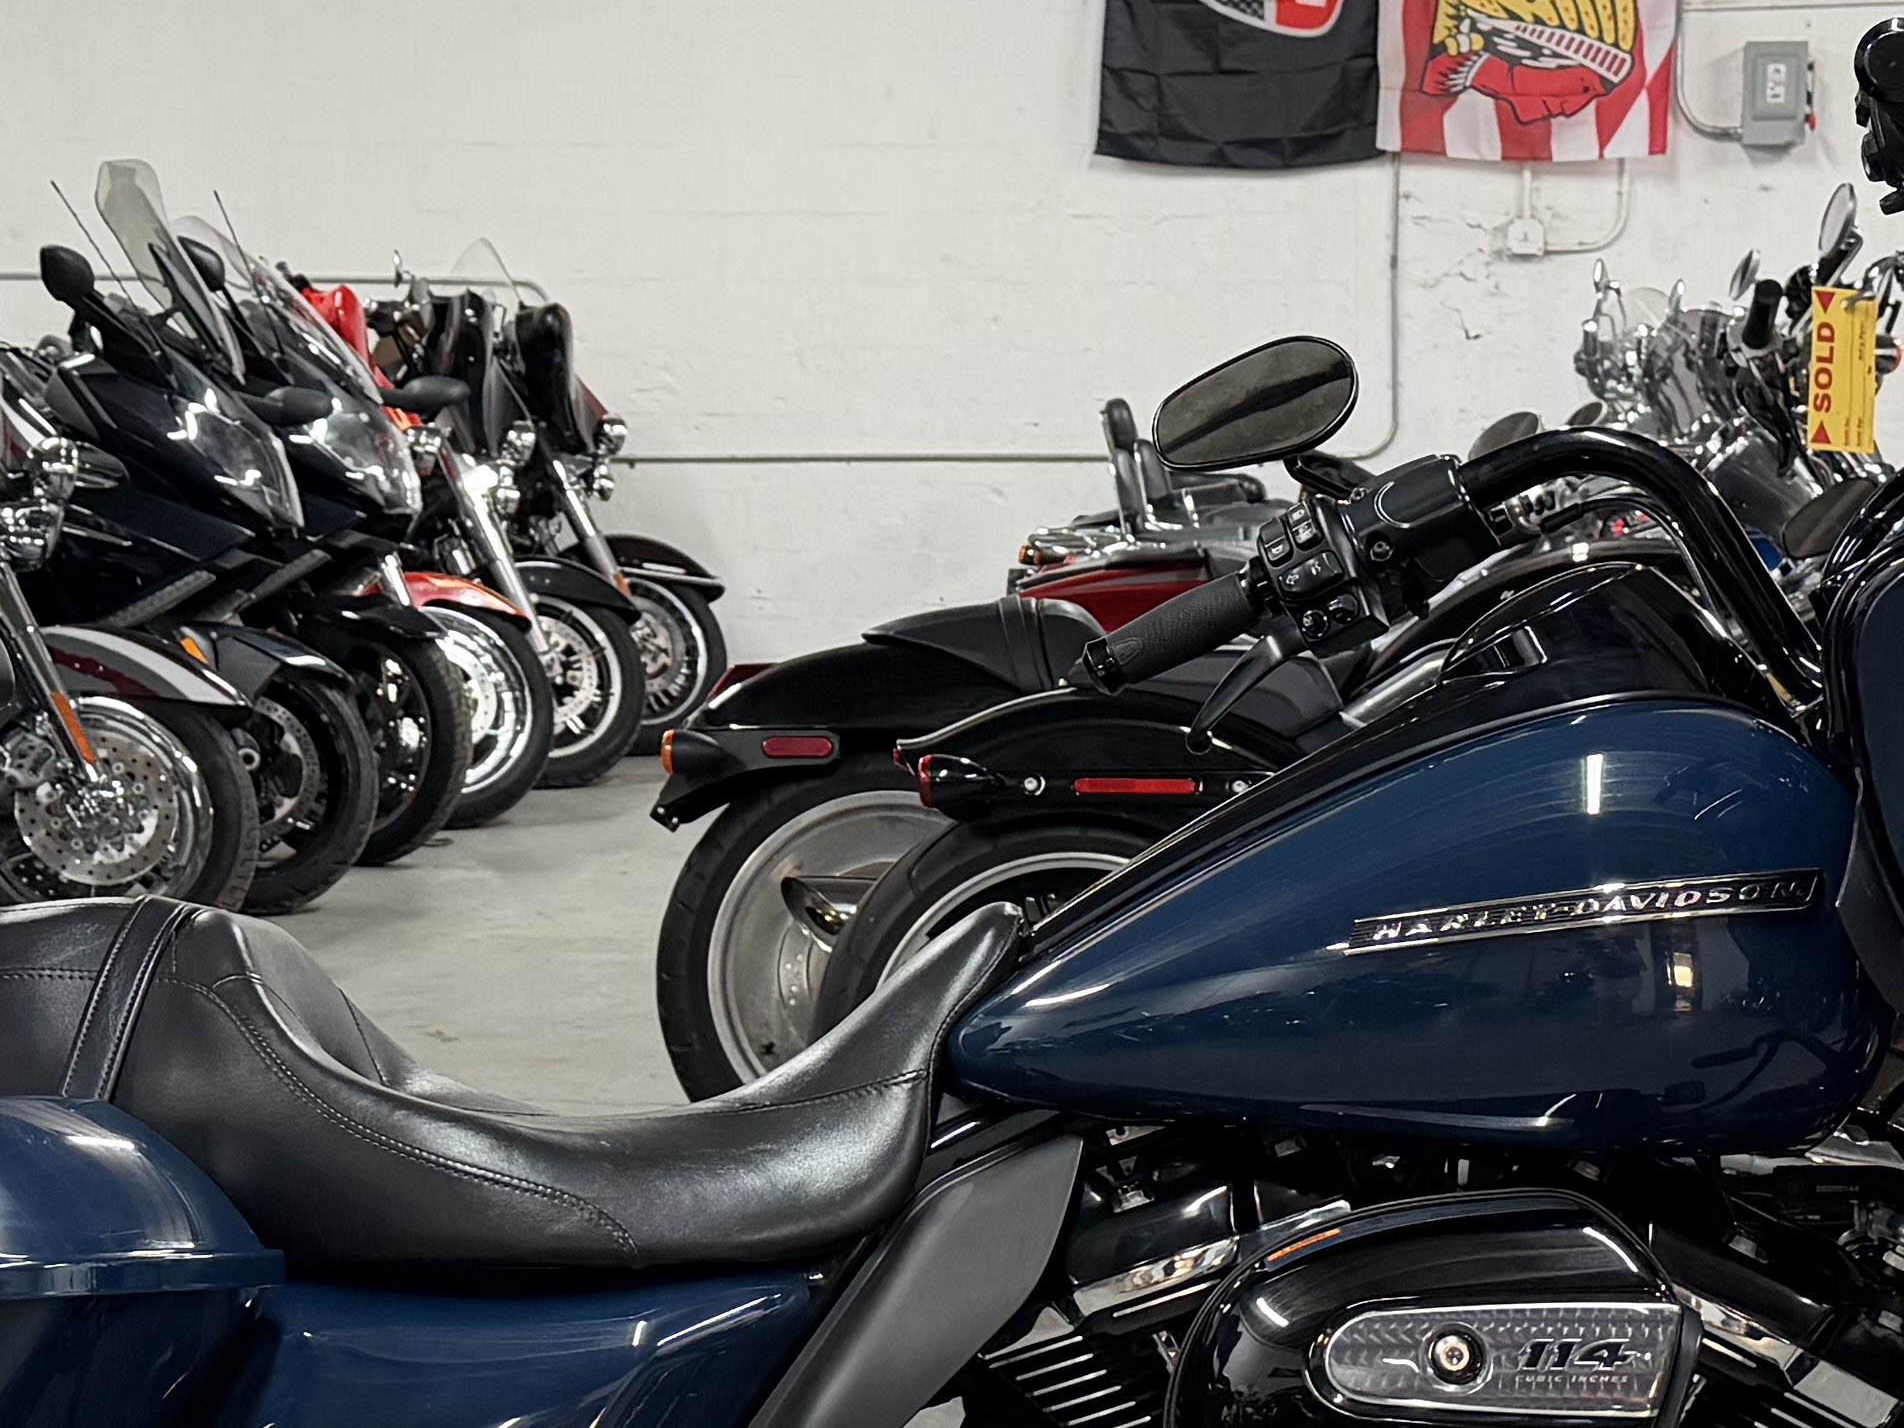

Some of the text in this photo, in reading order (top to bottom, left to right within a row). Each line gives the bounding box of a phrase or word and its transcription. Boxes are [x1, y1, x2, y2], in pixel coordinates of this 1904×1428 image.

[1813, 321, 1836, 413] SOLD
[1371, 880, 1809, 941] HARLEY-DAVIDSON
[1517, 1338, 1644, 1372] 114
[1515, 1374, 1628, 1384] CUBIC INCHES
